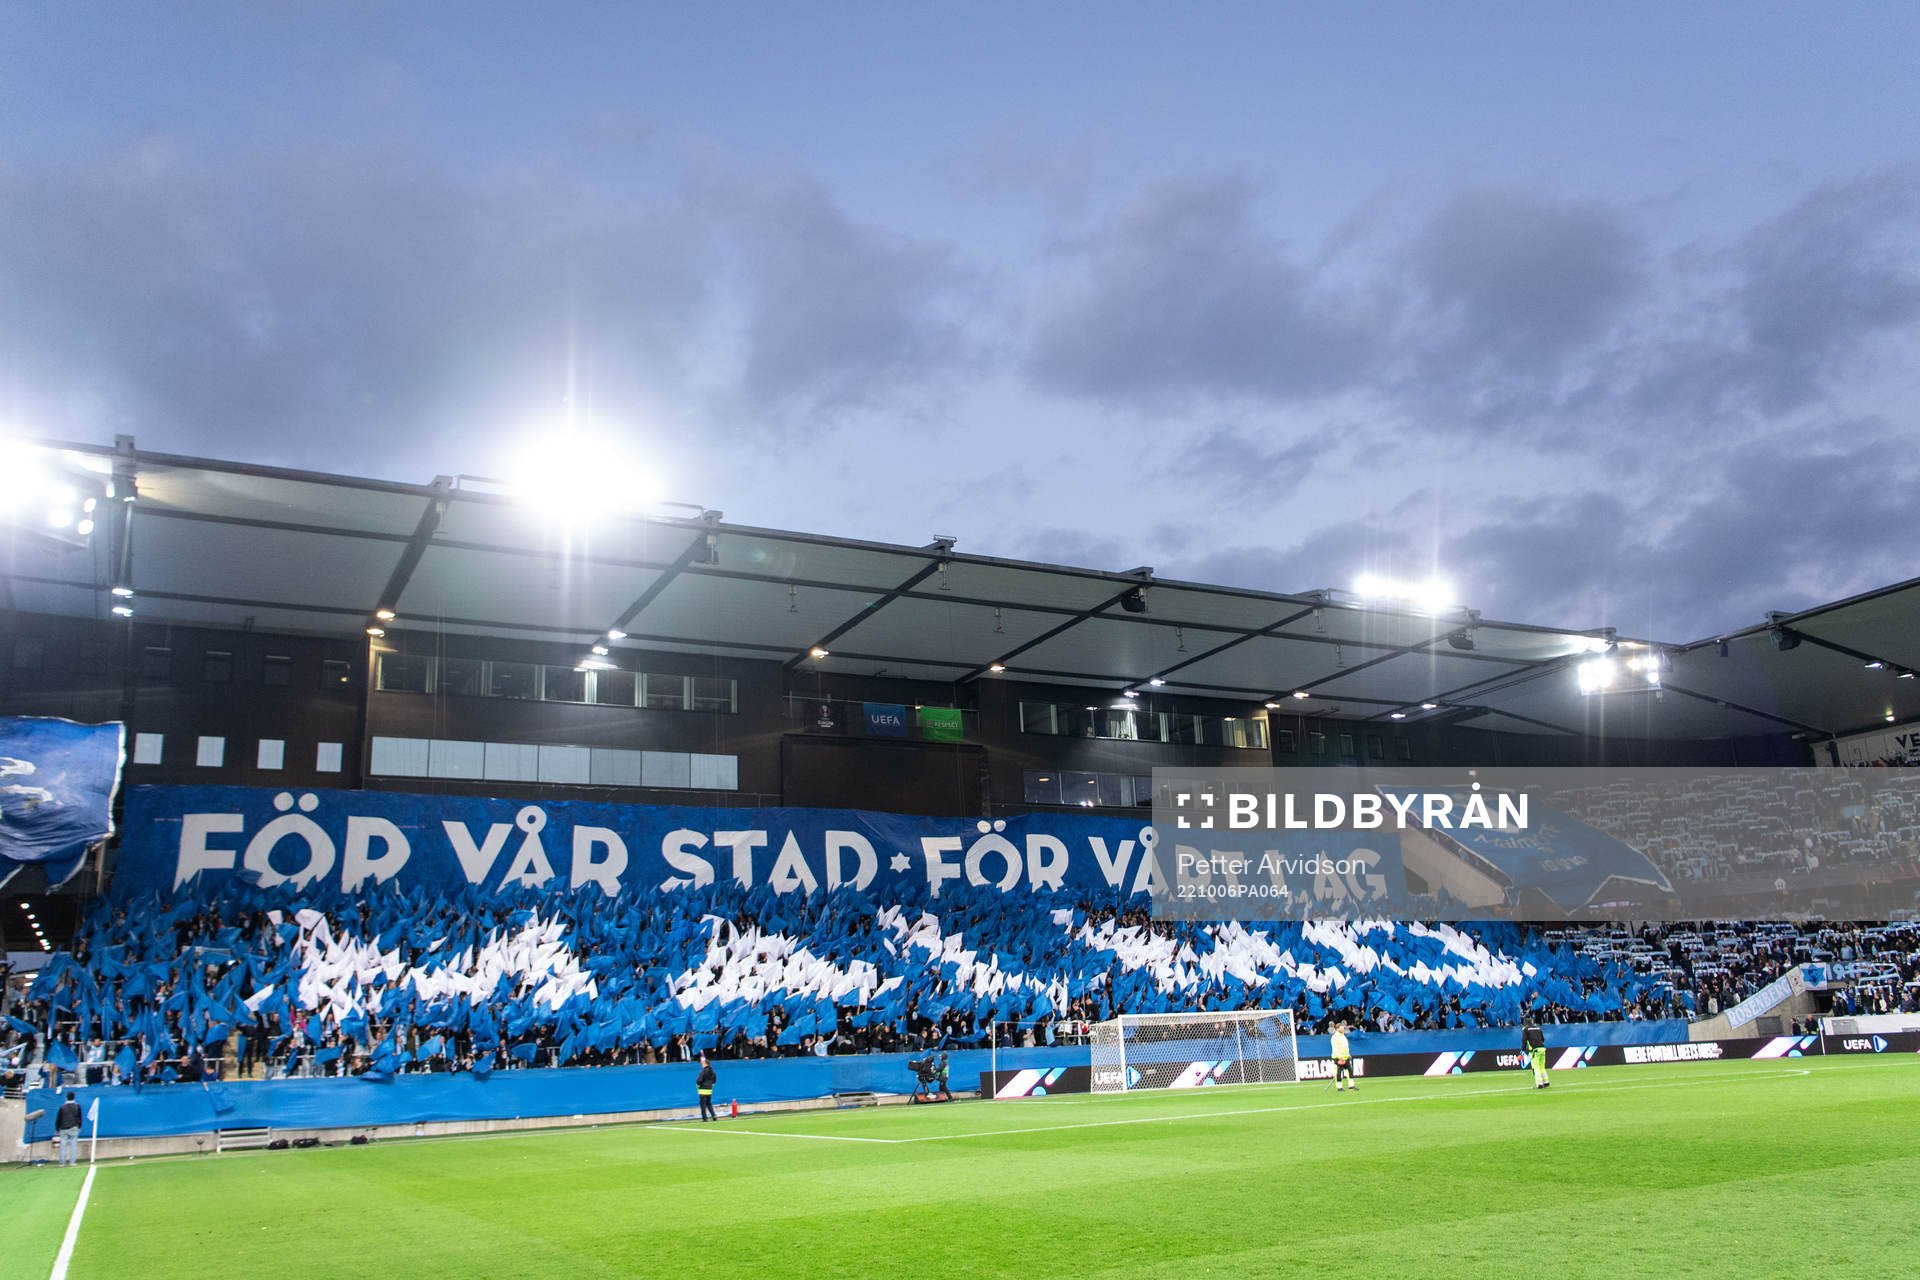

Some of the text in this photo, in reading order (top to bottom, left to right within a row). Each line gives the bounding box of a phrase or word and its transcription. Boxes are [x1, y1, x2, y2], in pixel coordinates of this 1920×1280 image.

[871, 714, 900, 726] UEFA
[172, 791, 1388, 903] FÖR VÅR STAD FÖR VÅRT LAG
[1729, 979, 1792, 1026] ROSENBERG
[1843, 1039, 1873, 1050] UEFA
[1496, 1054, 1520, 1067] UEFA
[1094, 1071, 1123, 1085] UEFA
